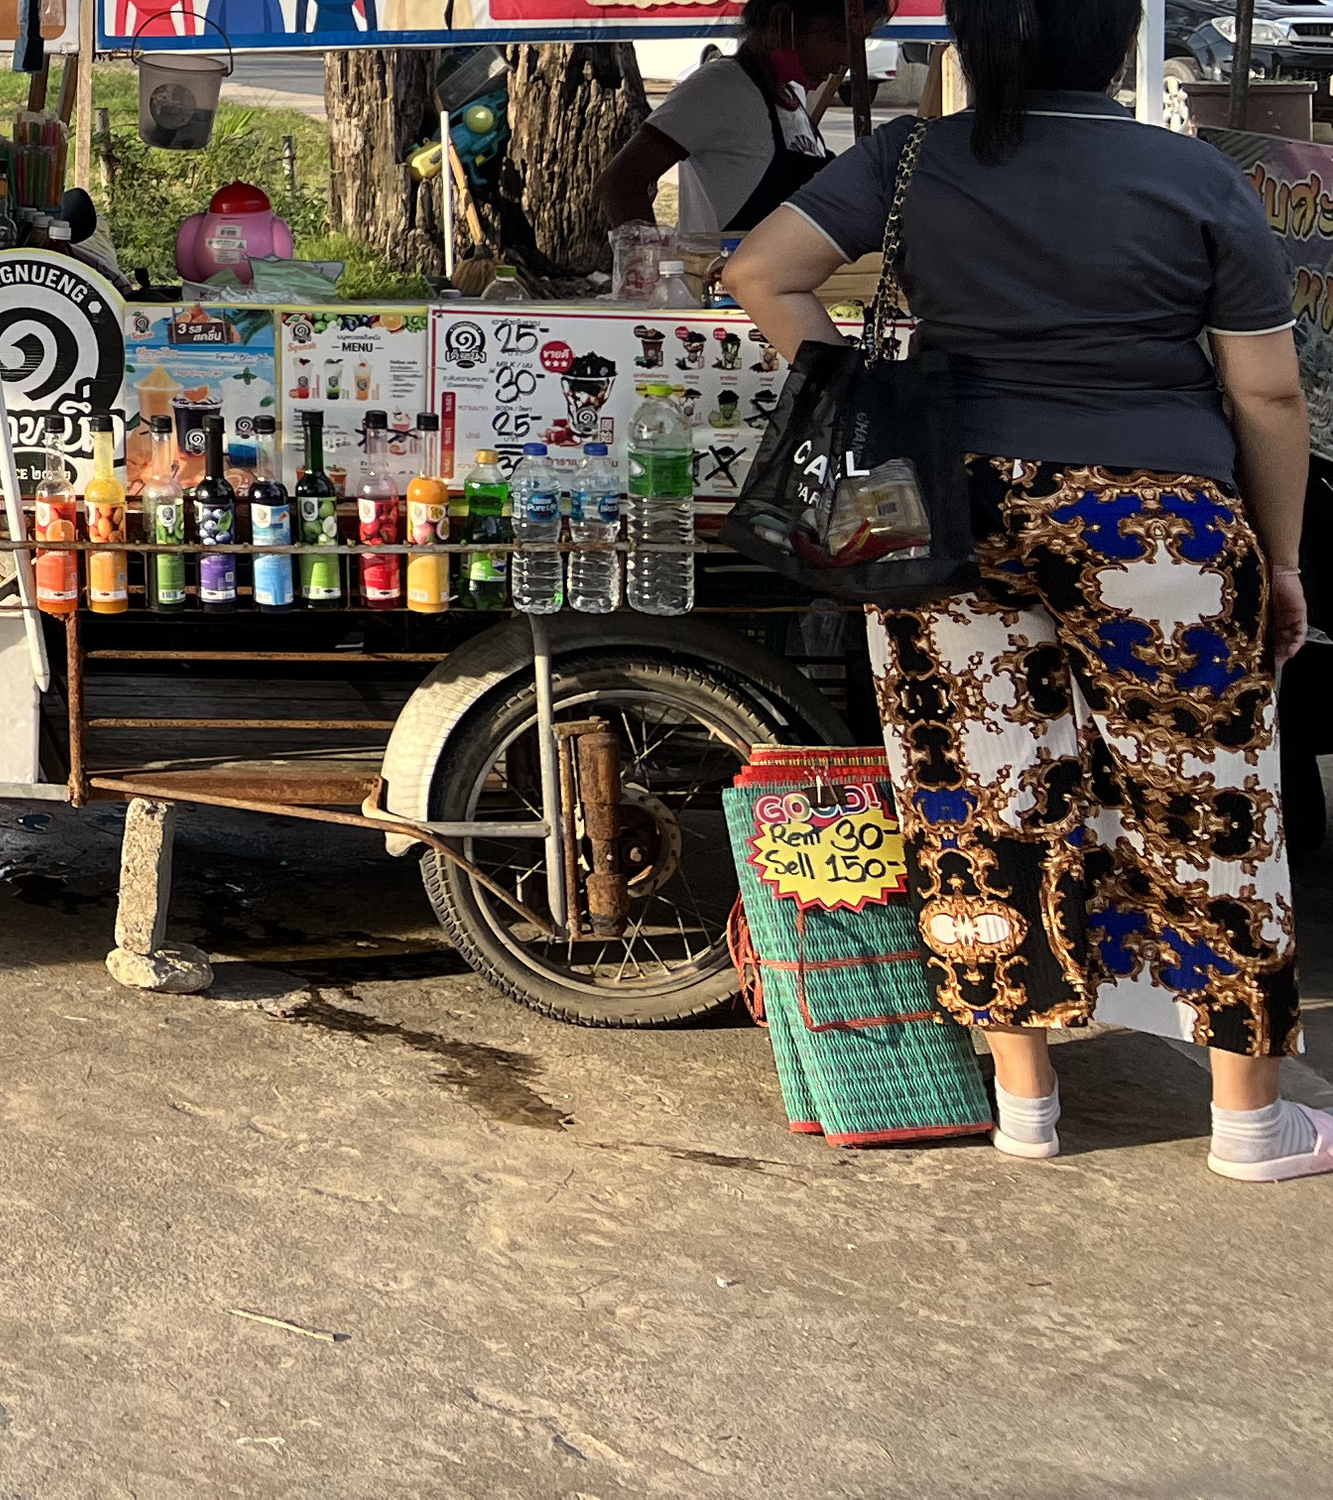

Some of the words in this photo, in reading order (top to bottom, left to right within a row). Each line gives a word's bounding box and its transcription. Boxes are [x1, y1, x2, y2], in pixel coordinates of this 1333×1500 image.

[177, 323, 188, 334] 3
[188, 324, 203, 334] รส
[192, 325, 222, 341] สดชื่น
[341, 342, 374, 353] MENU
[764, 851, 816, 881] Sell
